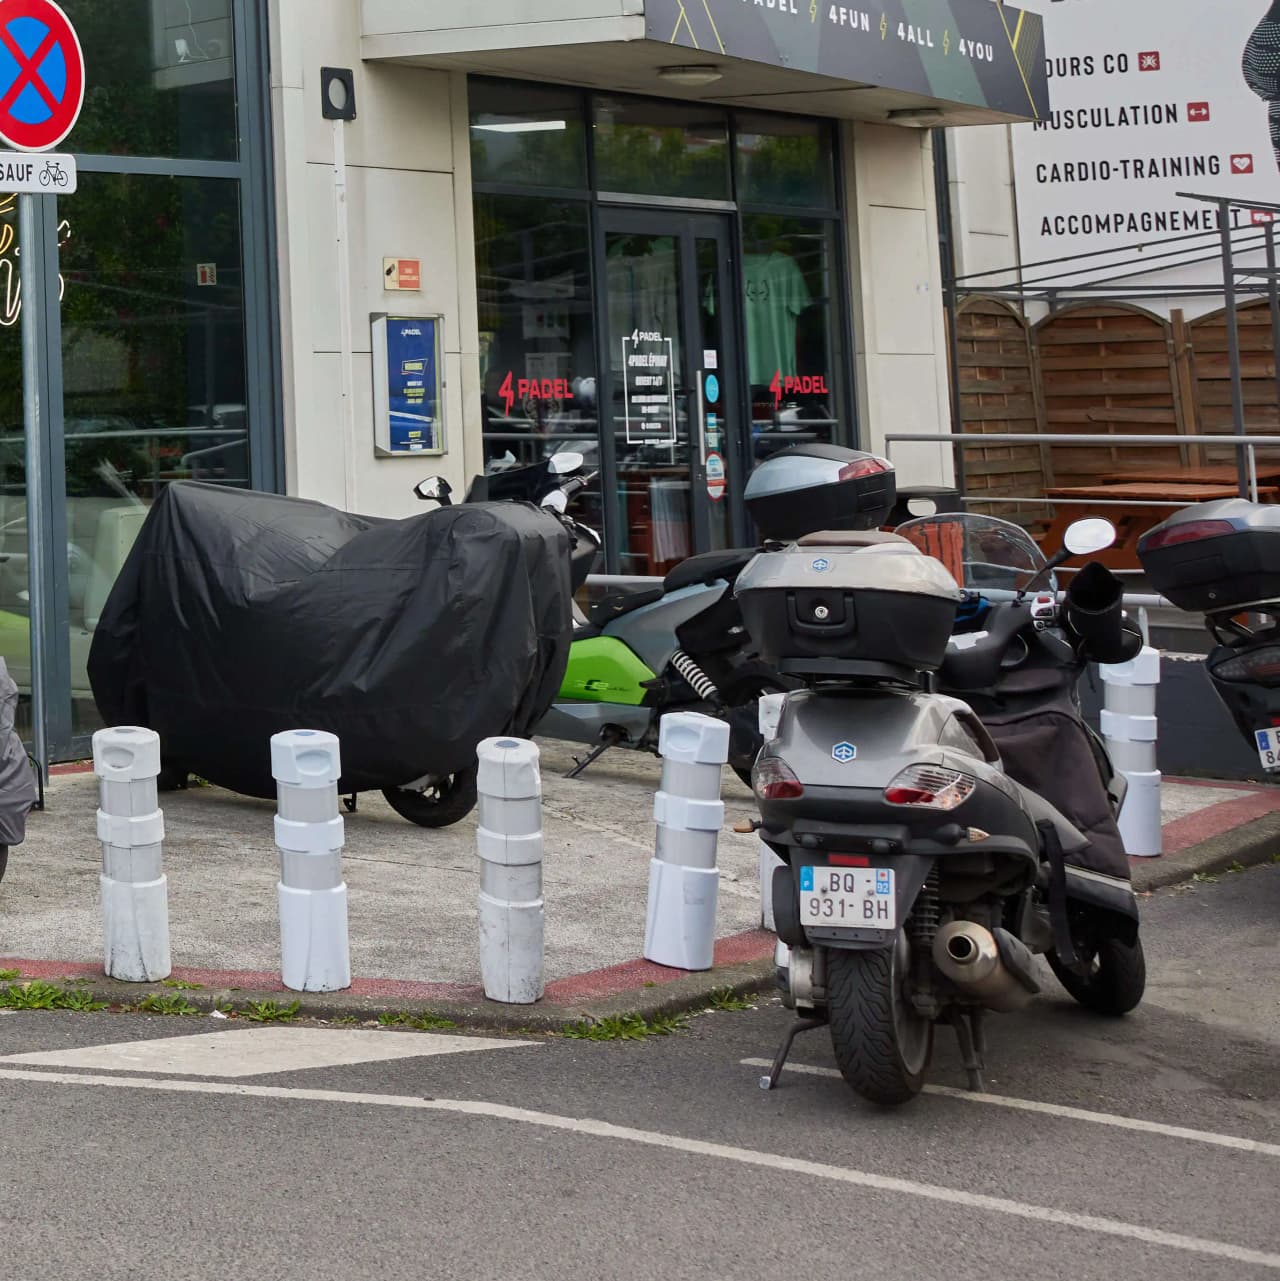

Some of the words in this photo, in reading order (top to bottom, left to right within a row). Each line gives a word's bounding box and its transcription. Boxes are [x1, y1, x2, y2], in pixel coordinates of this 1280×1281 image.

[829, 5, 870, 32] 4FUN
[897, 22, 934, 48] 4ALL
[959, 38, 994, 62] 4YOU
[1045, 55, 1095, 78] OURS
[1103, 53, 1129, 74] CO
[1036, 154, 1221, 183] CARDIO-TRAINING
